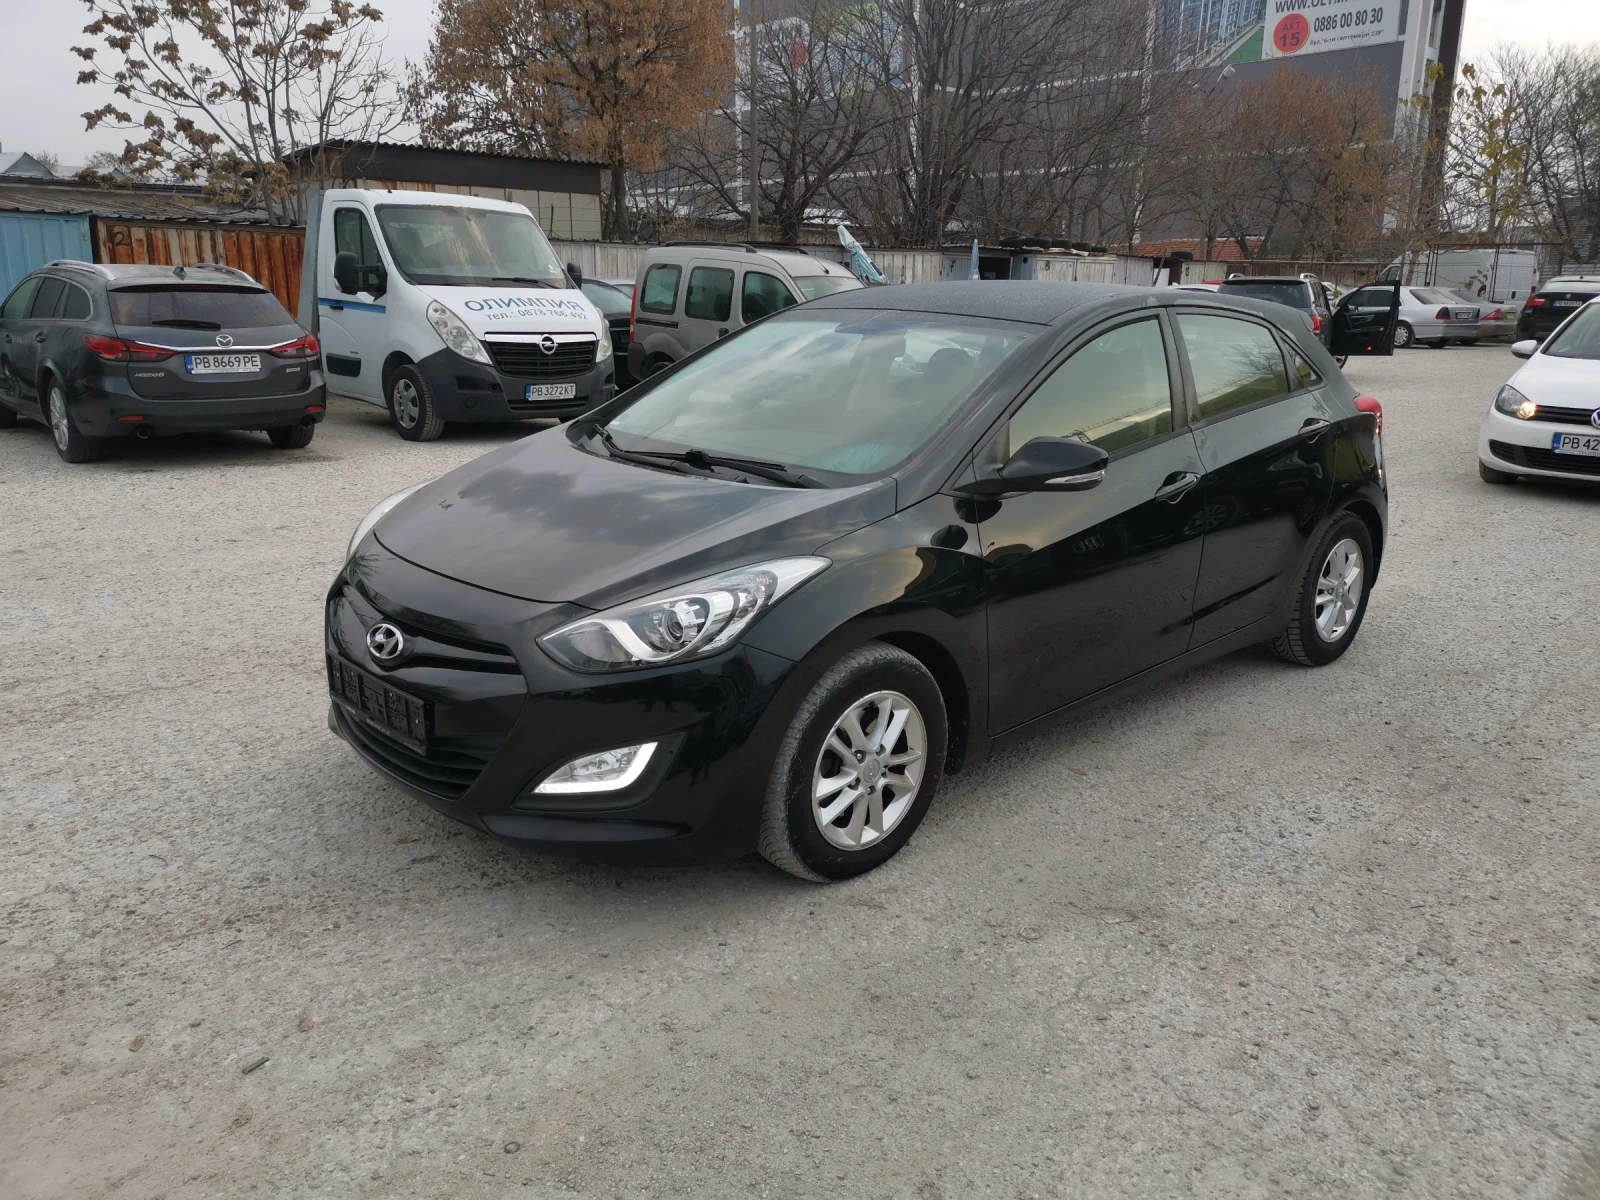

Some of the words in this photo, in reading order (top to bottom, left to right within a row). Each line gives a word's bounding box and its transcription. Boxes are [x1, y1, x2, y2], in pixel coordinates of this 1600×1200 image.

[1282, 21, 1301, 31] АКТ
[1313, 14, 1337, 32] 0886
[1340, 12, 1352, 28] 00
[1354, 10, 1367, 26] 80
[1370, 7, 1383, 24] 30
[1280, 32, 1300, 48] 15
[114, 231, 131, 246] 2
[464, 297, 585, 312] ОЛИМПИЯ
[517, 308, 546, 317] 0878
[547, 309, 568, 318] 766
[213, 356, 241, 368] 8669
[243, 355, 259, 367] PE
[545, 385, 563, 396] 3272
[1562, 436, 1580, 449] PB
